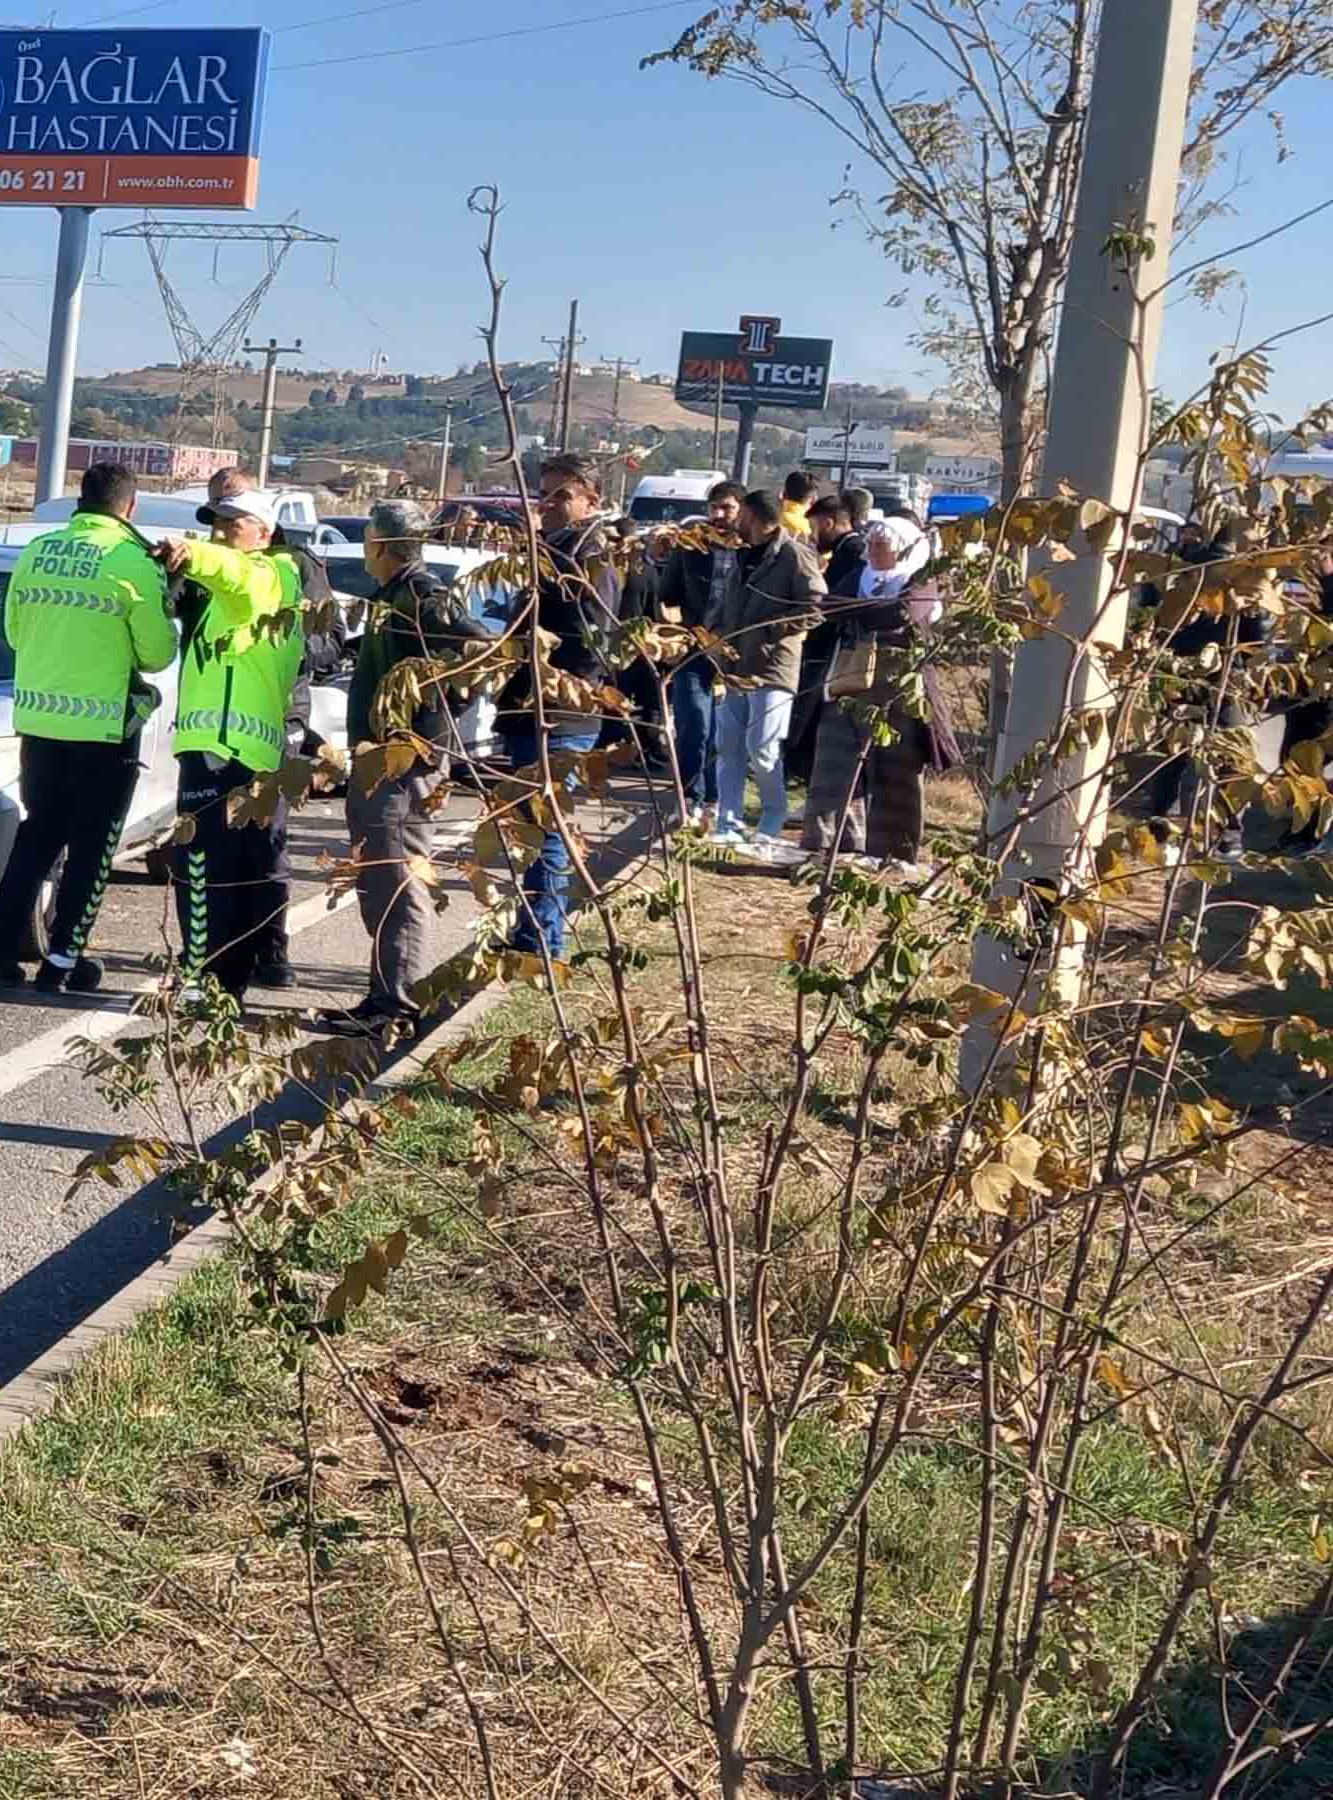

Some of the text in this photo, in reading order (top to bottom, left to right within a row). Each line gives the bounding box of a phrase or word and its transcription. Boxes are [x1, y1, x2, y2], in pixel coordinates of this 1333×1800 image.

[14, 43, 238, 105] BAĞLAR
[7, 109, 238, 152] HASTANESİ
[32, 170, 55, 191] 21
[62, 171, 86, 191] 21
[116, 175, 235, 191] www.obh.com.tr
[752, 362, 823, 386] TECH
[31, 555, 102, 580] POLİSİ
